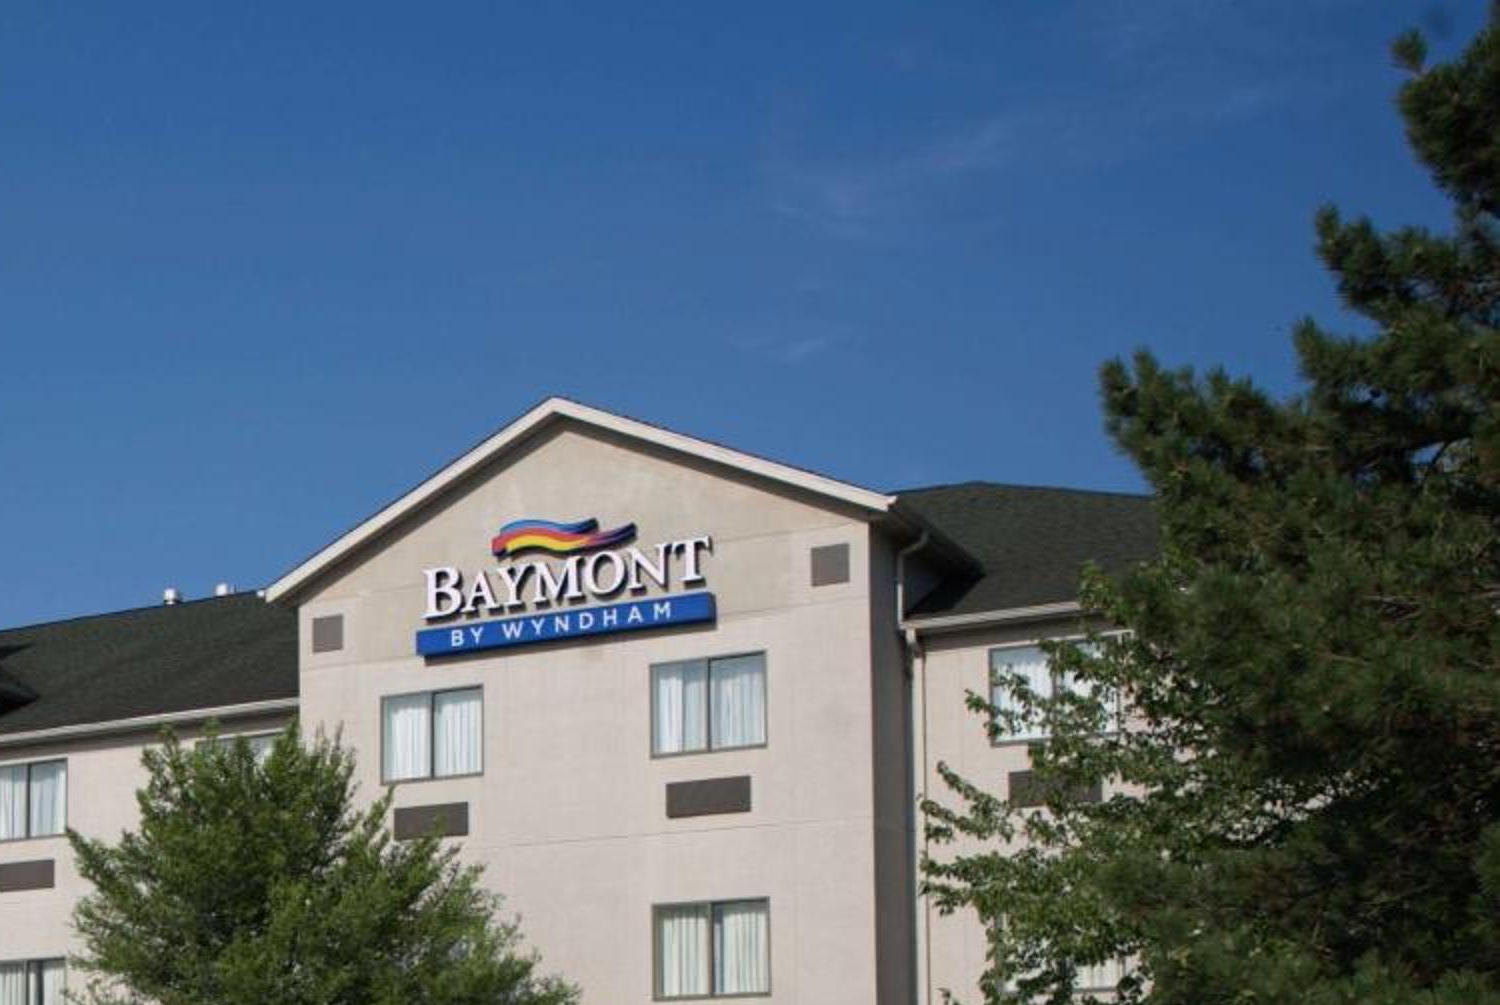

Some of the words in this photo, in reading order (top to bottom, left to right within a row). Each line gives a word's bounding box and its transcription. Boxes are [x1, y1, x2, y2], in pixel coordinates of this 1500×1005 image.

[421, 535, 711, 619] BAYMONT
[451, 626, 485, 648] BY
[502, 601, 673, 641] WYNDHAM
